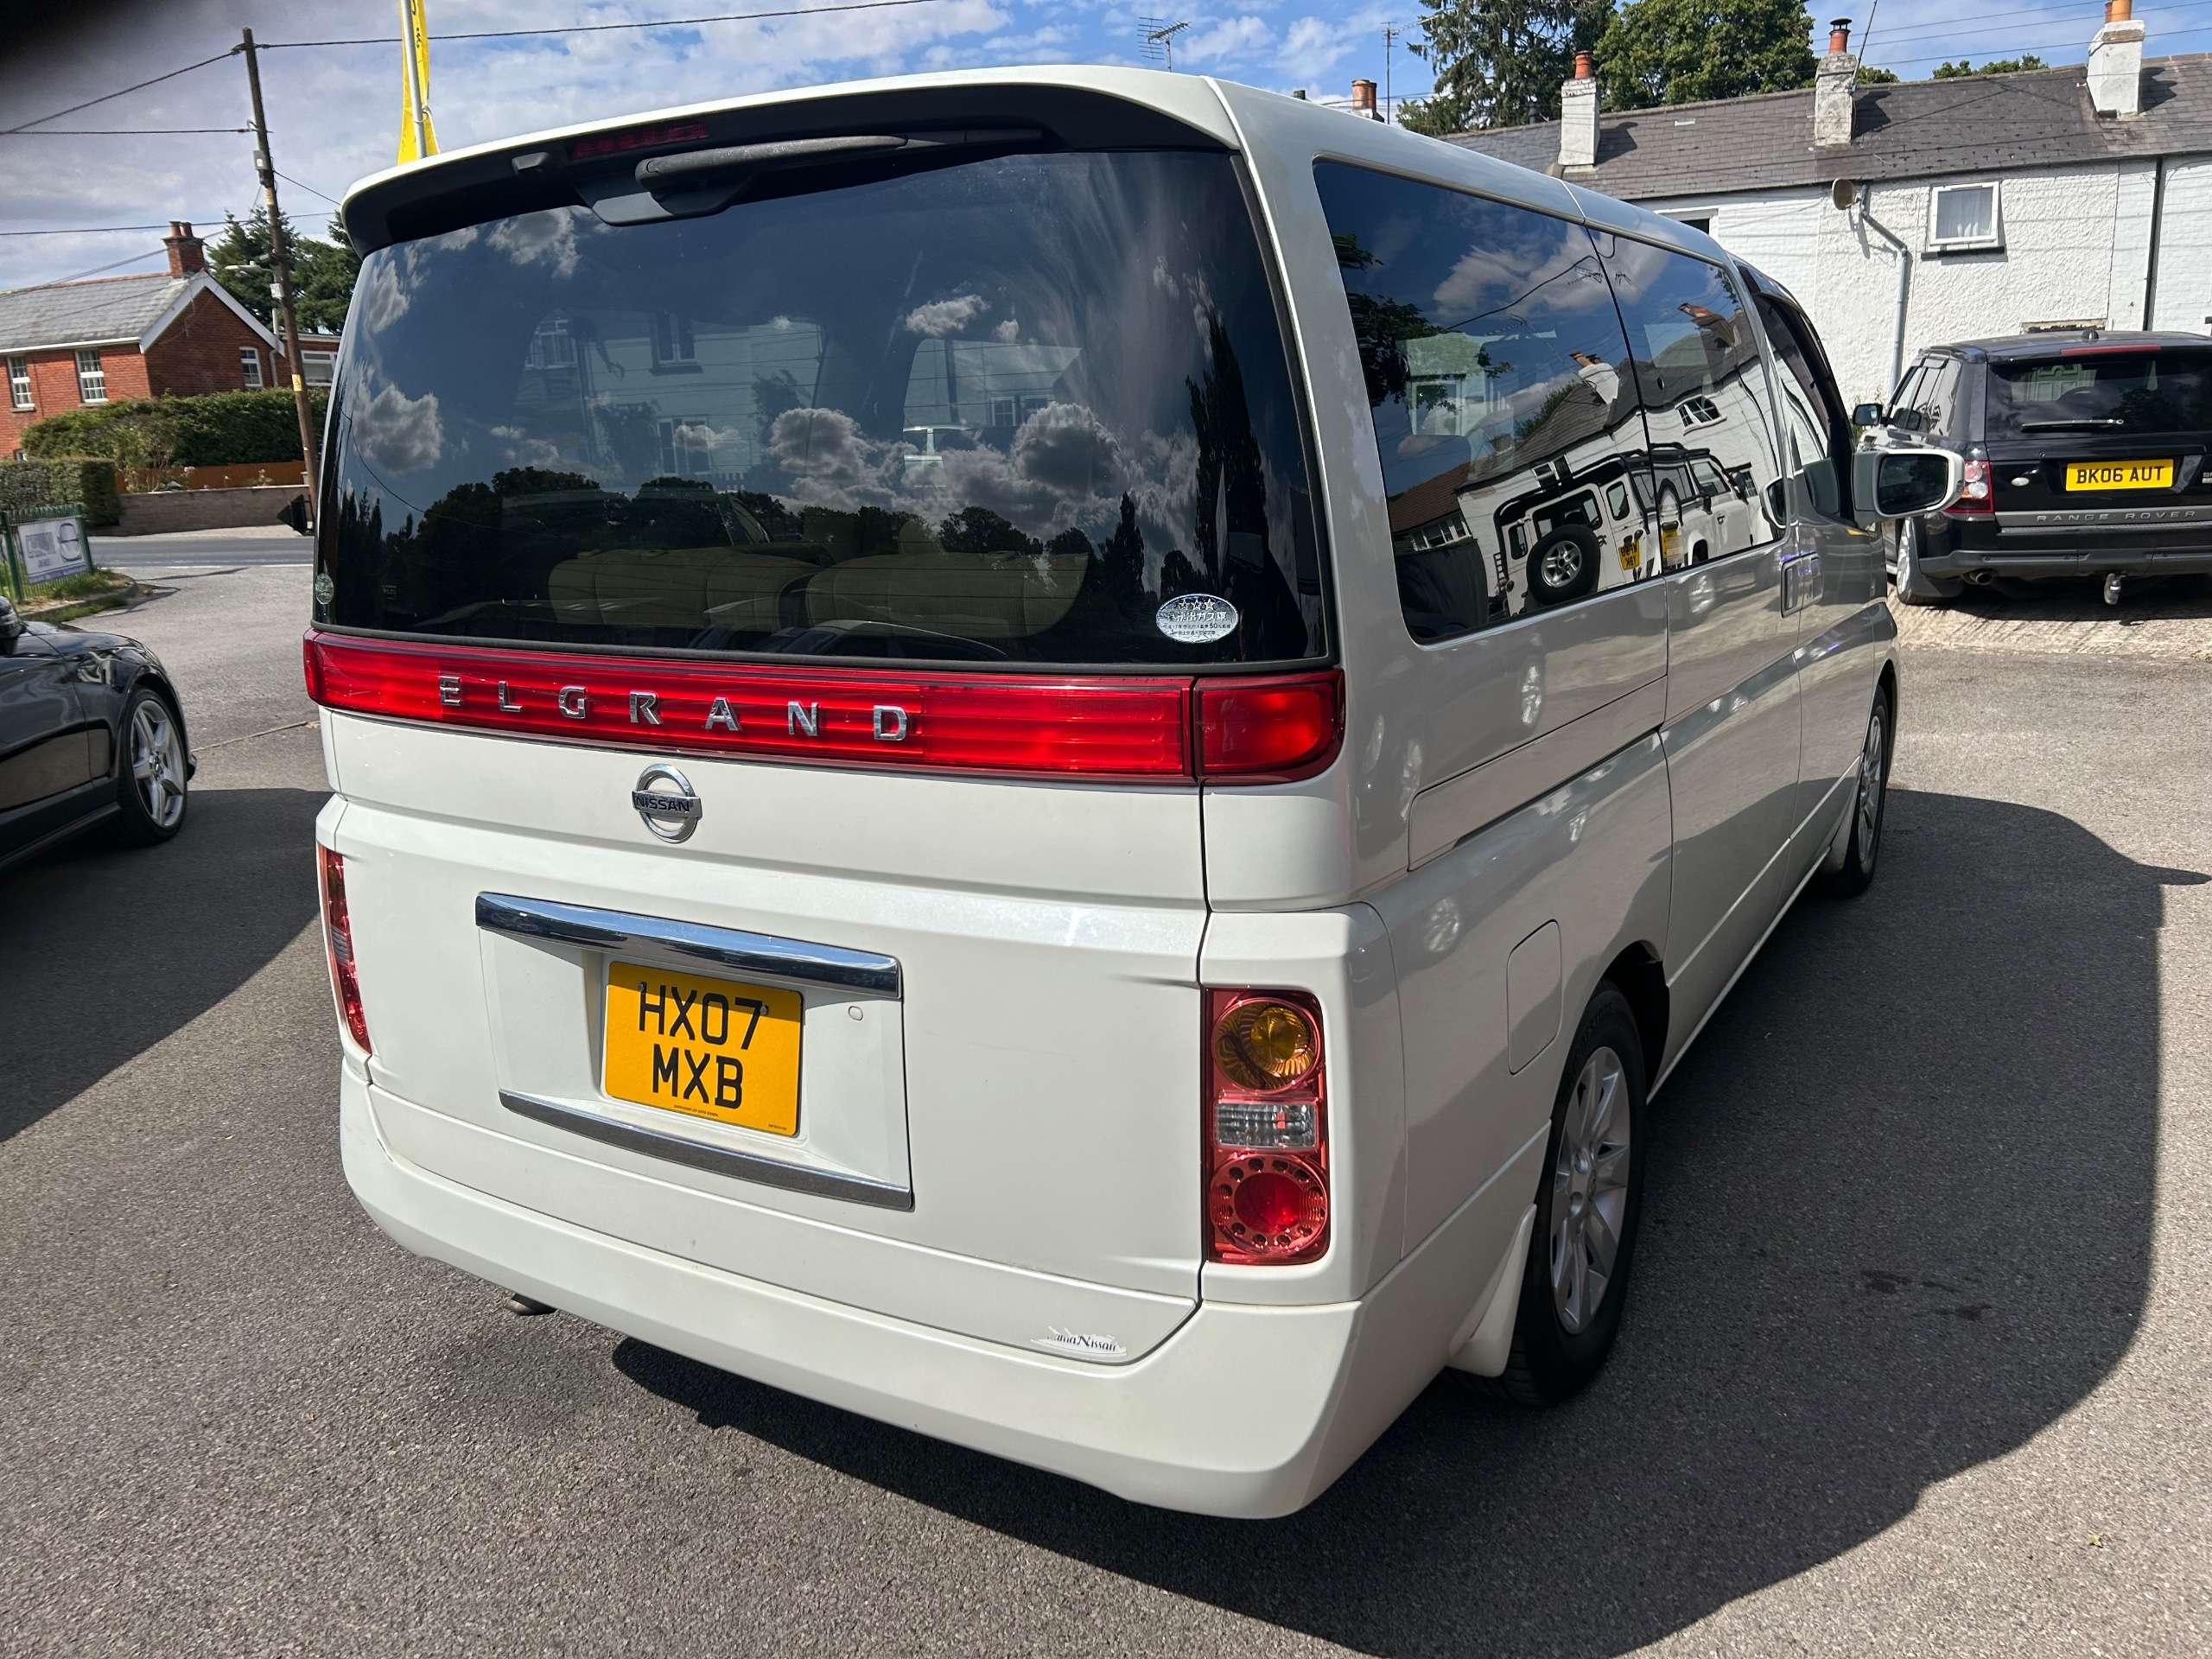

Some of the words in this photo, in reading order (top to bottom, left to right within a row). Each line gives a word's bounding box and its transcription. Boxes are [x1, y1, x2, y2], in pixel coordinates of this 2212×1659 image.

[2076, 467, 2124, 484] BK06
[2129, 466, 2164, 482] AUT
[2036, 513, 2109, 522] RANGE
[2125, 511, 2196, 519] ROVER
[439, 676, 911, 741] ELGRAND
[635, 795, 690, 812] NISSAN
[639, 982, 766, 1051] HX07
[652, 1043, 744, 1109] MXB
